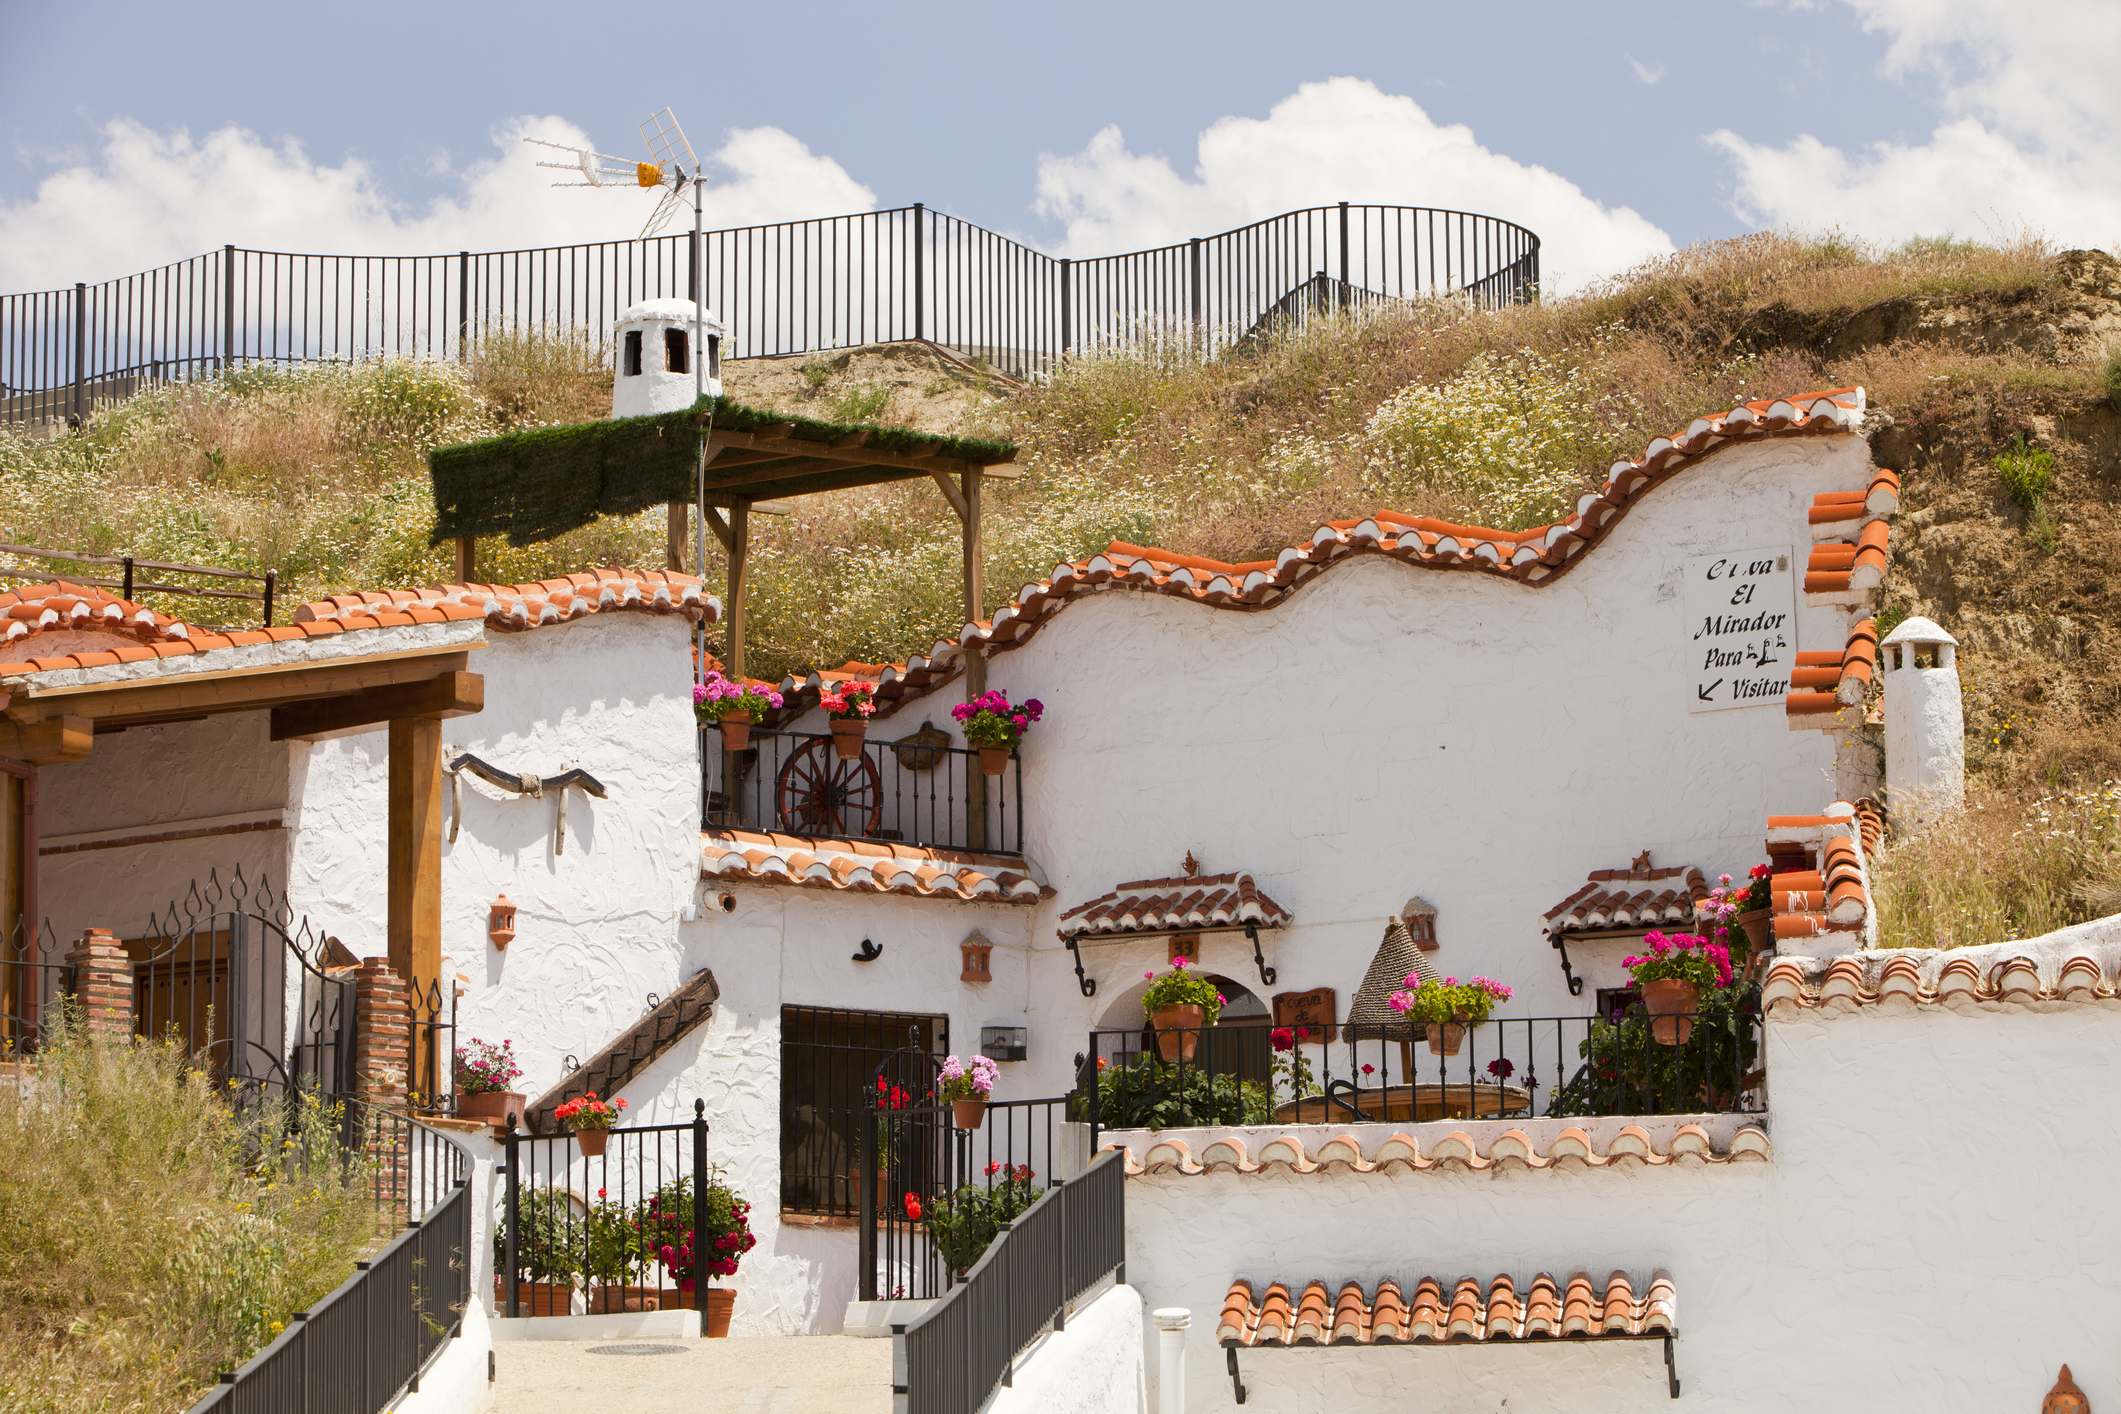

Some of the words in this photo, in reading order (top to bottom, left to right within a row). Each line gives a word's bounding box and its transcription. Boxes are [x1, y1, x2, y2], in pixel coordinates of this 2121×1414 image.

[1706, 559, 1774, 581] Cva
[1730, 583, 1756, 606] El
[1693, 610, 1786, 641] Mirador
[1703, 647, 1743, 670] Para
[1732, 677, 1788, 700] Visitar
[1173, 940, 1194, 957] 33
[1295, 1008, 1309, 1022] de
